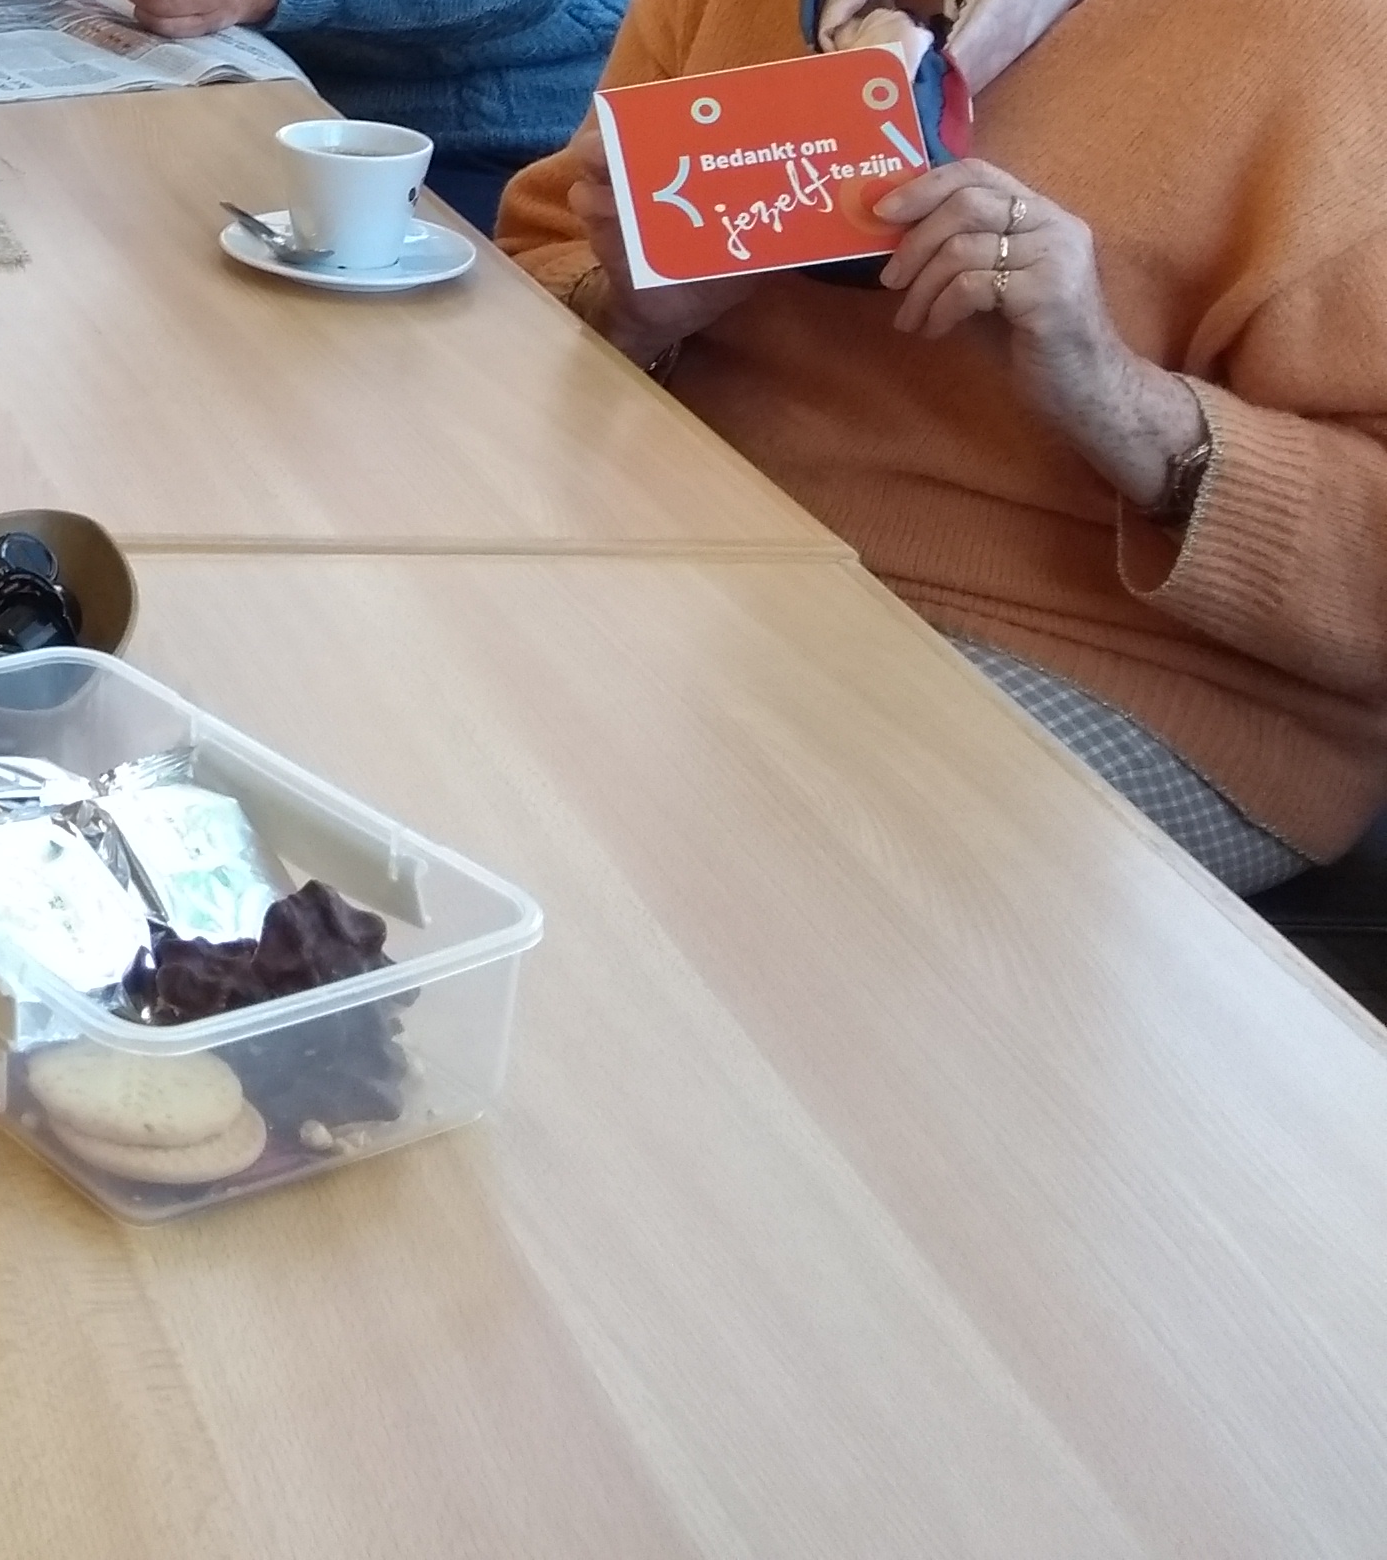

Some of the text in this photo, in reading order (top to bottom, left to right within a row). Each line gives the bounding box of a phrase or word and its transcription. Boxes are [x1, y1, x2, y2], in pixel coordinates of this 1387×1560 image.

[700, 136, 837, 172] Bedankt om
[714, 154, 902, 261] jezelf te zijn
